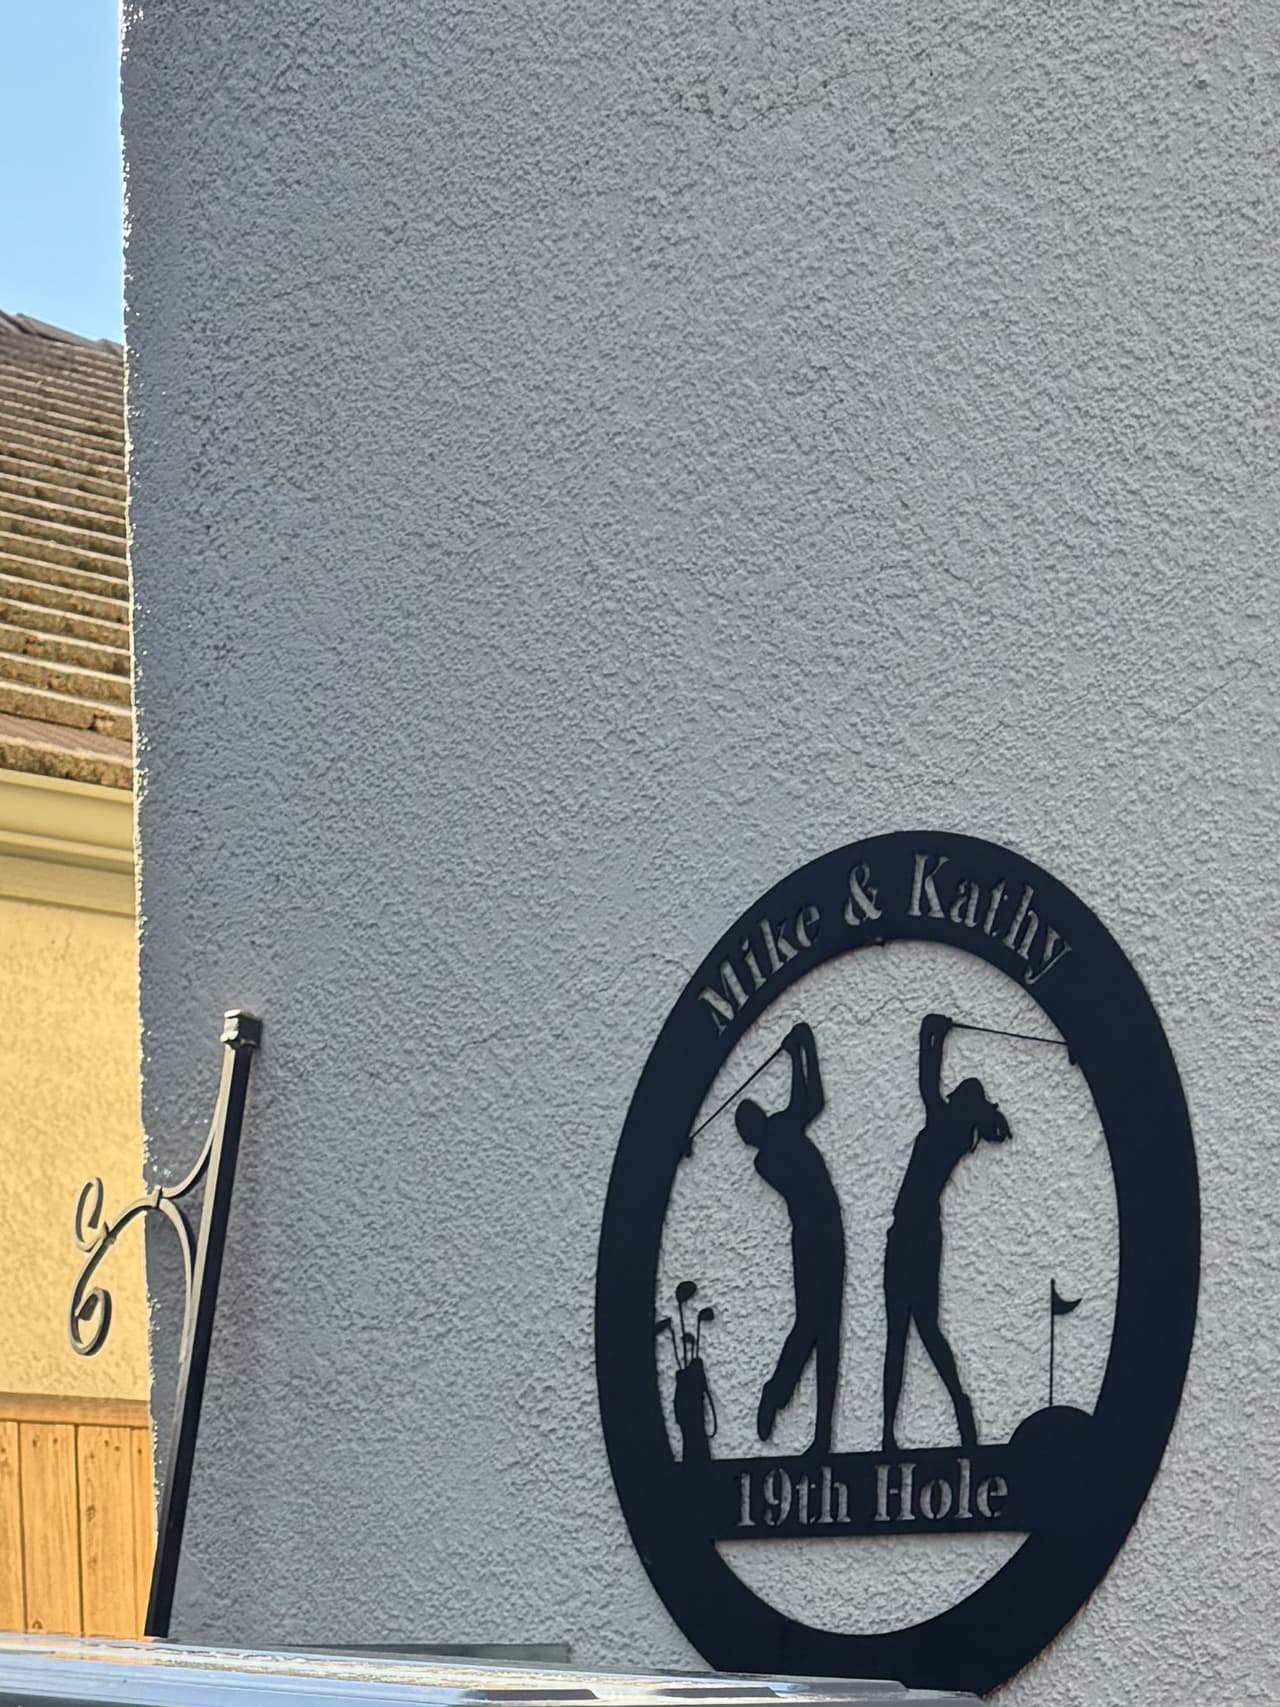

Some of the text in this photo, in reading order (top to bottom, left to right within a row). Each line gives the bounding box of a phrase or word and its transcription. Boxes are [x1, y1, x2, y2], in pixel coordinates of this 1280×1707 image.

[698, 854, 1073, 1033] Mike & Kathy
[735, 1457, 1009, 1527] 19th Hole
